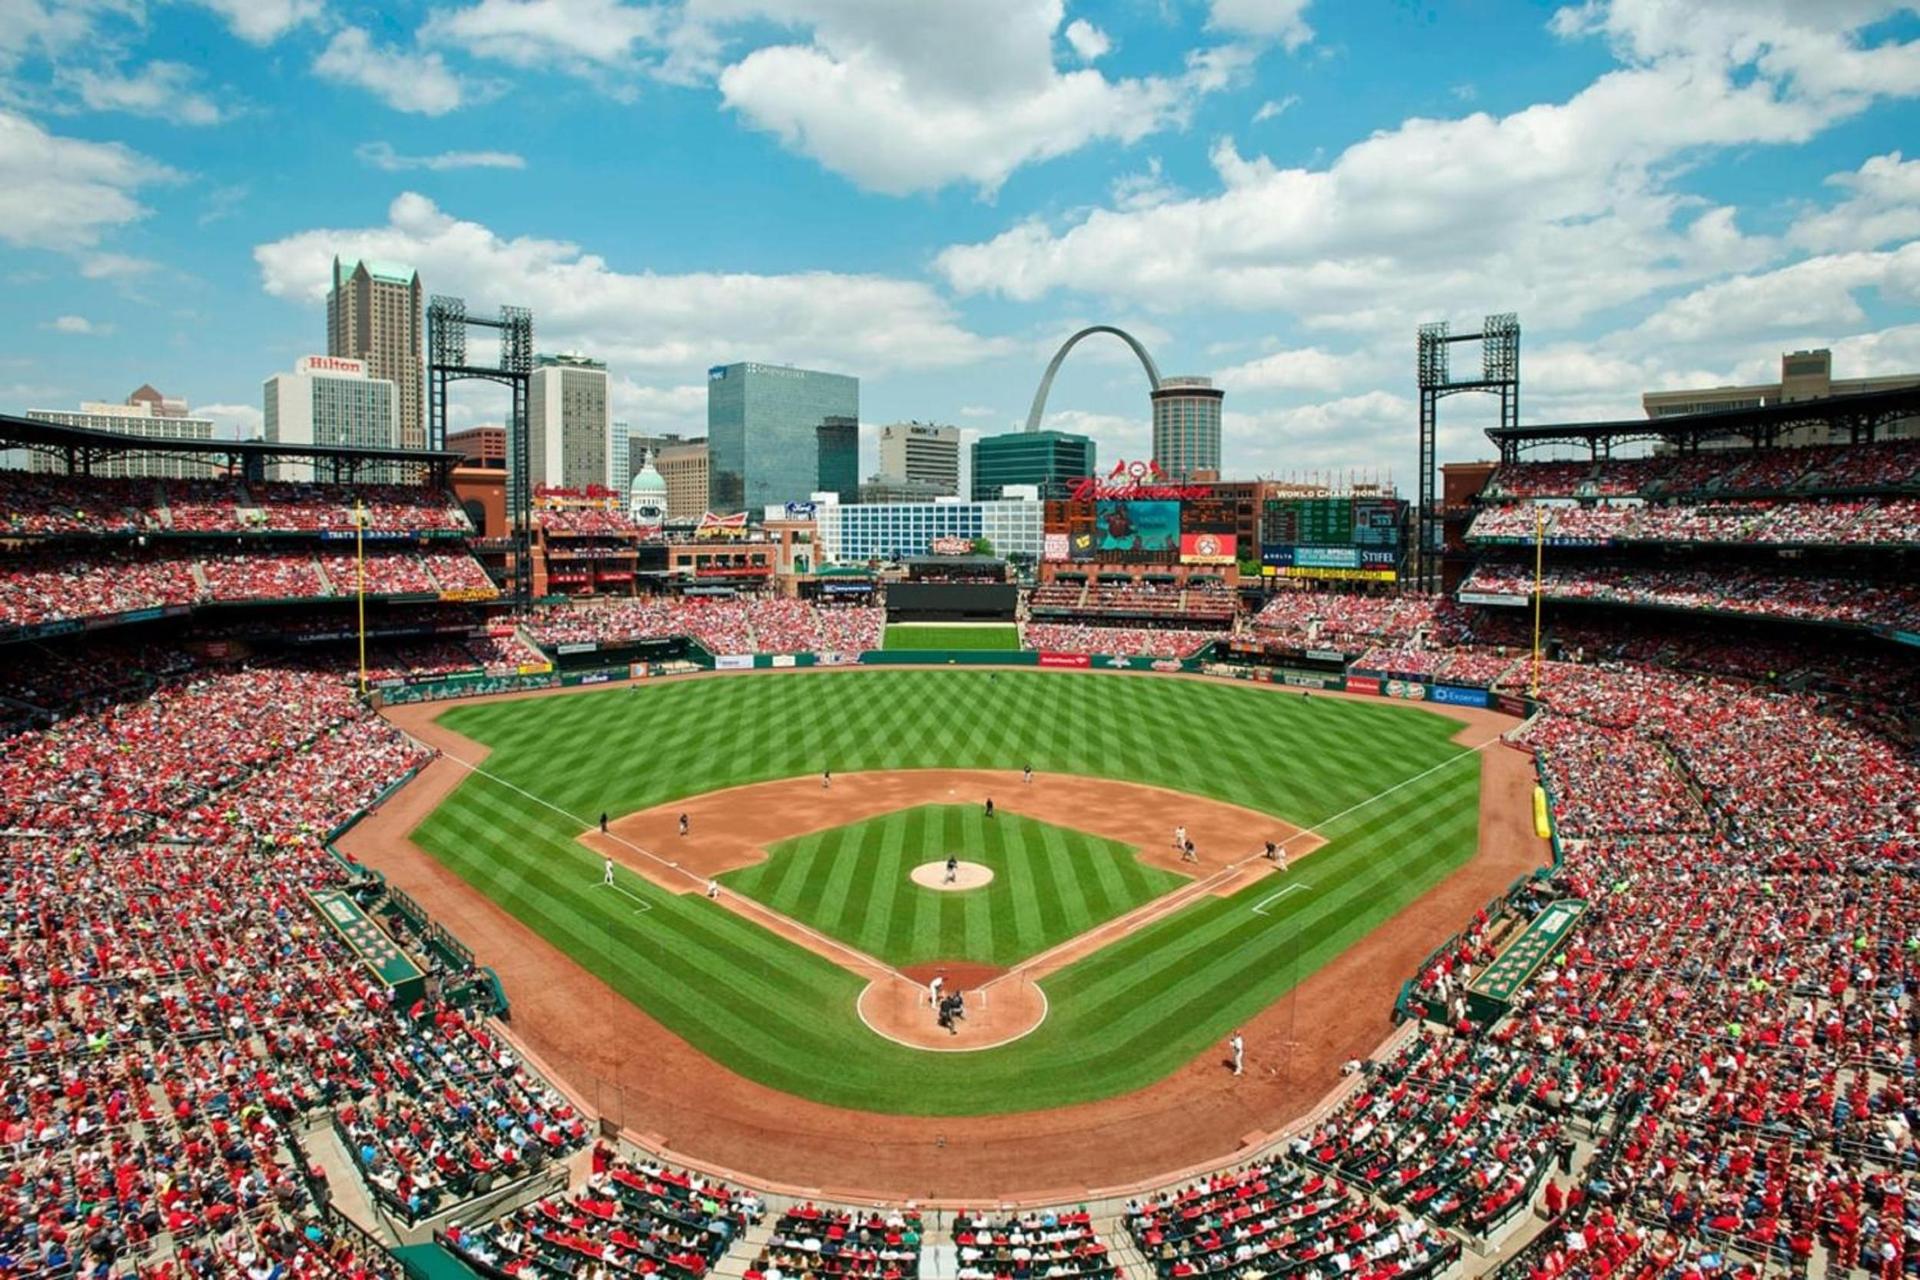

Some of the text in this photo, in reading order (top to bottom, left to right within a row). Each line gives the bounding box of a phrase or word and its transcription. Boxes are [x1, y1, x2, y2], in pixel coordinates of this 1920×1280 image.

[309, 356, 360, 372] Hilton
[1065, 477, 1214, 503] Budweiser
[1277, 488, 1382, 498] WORLD CHAMPIONS
[1362, 548, 1395, 562] STIFEL
[1449, 691, 1487, 703] Experian
